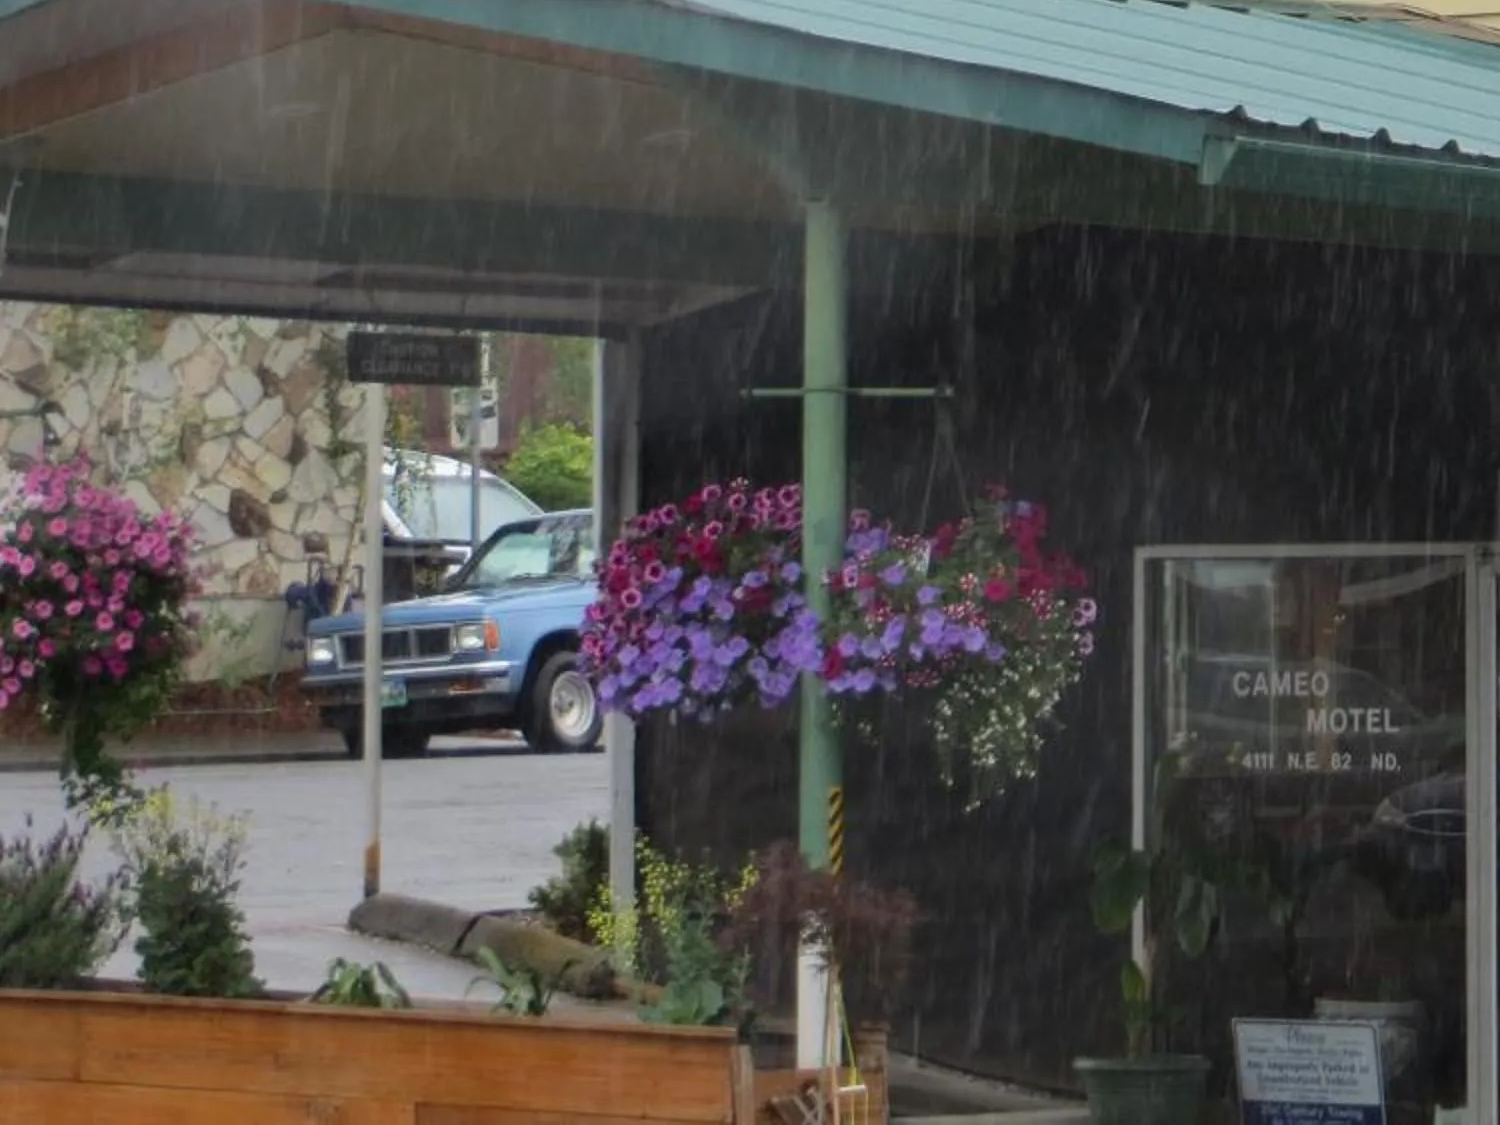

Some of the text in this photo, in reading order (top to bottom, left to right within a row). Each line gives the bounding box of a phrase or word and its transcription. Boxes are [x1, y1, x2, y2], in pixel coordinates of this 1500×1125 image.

[1233, 670, 1329, 698] CAMEO
[1306, 707, 1400, 734] MOTEL
[1241, 751, 1274, 771] 4111
[1331, 751, 1353, 770] 82
